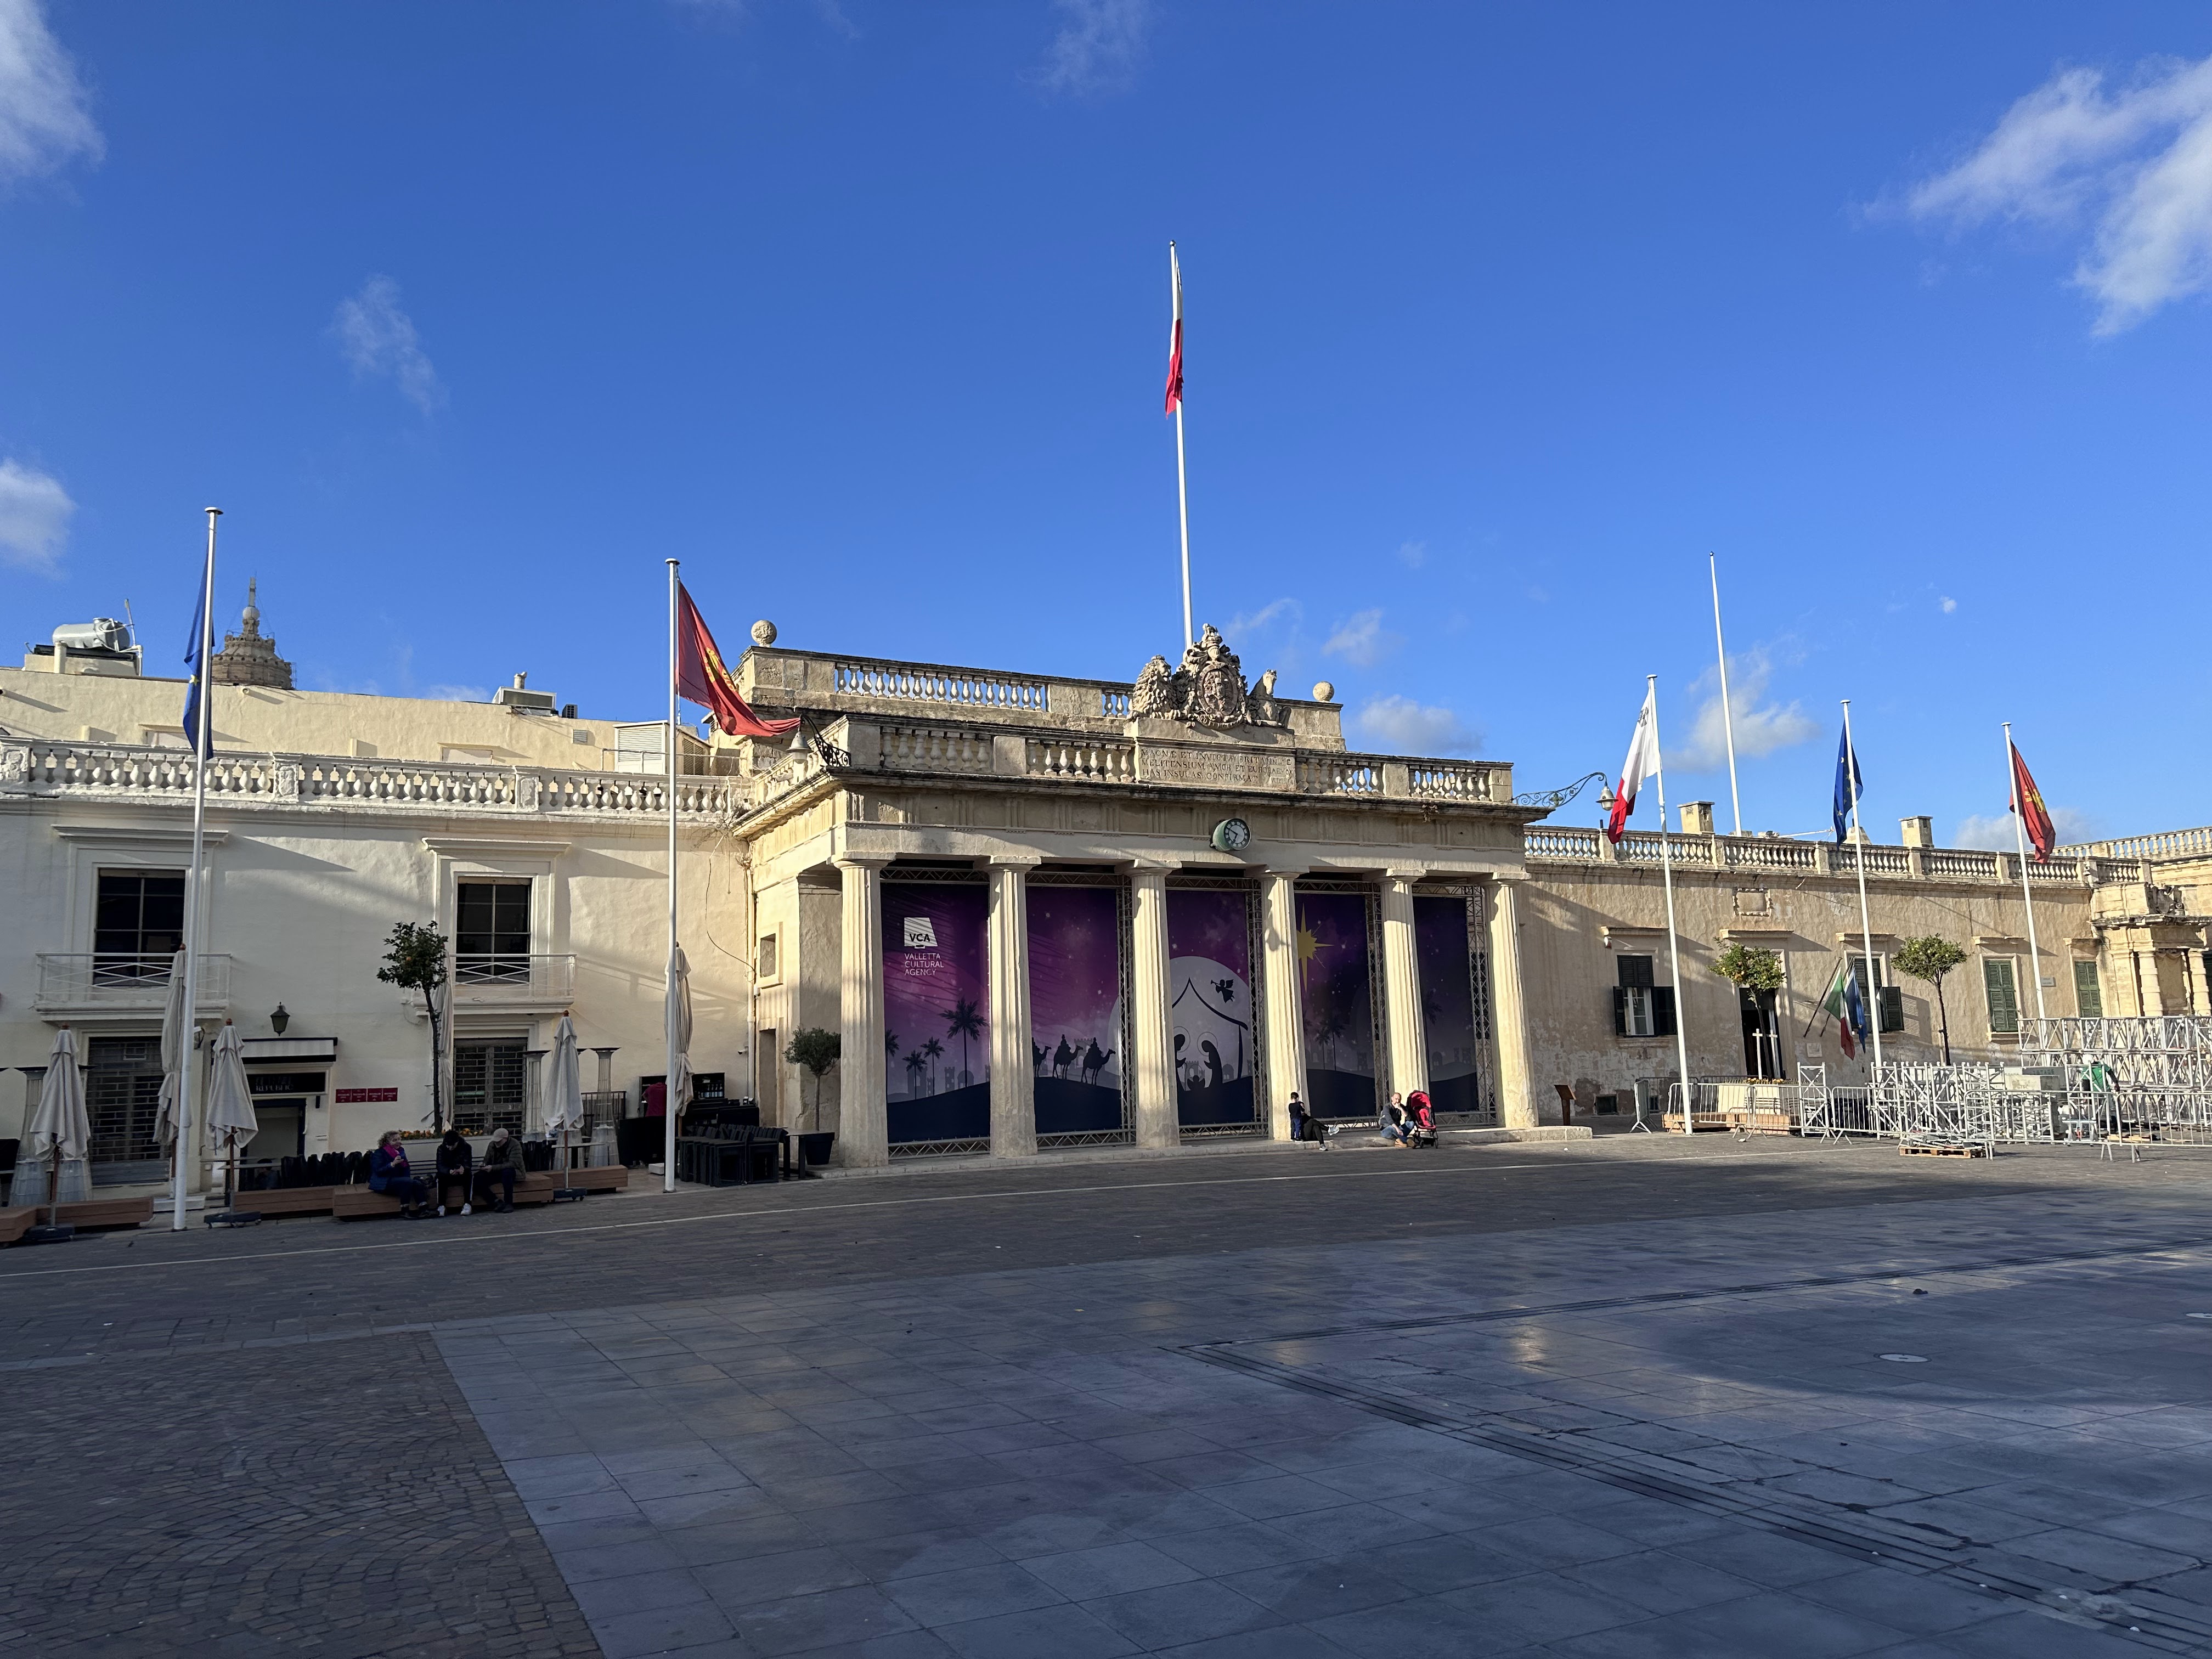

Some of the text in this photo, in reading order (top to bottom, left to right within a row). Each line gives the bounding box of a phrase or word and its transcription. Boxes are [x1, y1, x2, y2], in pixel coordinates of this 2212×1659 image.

[1142, 758, 1205, 769] MELITENSIUM
[1164, 770, 1203, 779] INSULAS
[1206, 772, 1258, 782] CONFIRMAT
[909, 933, 930, 942] VCA
